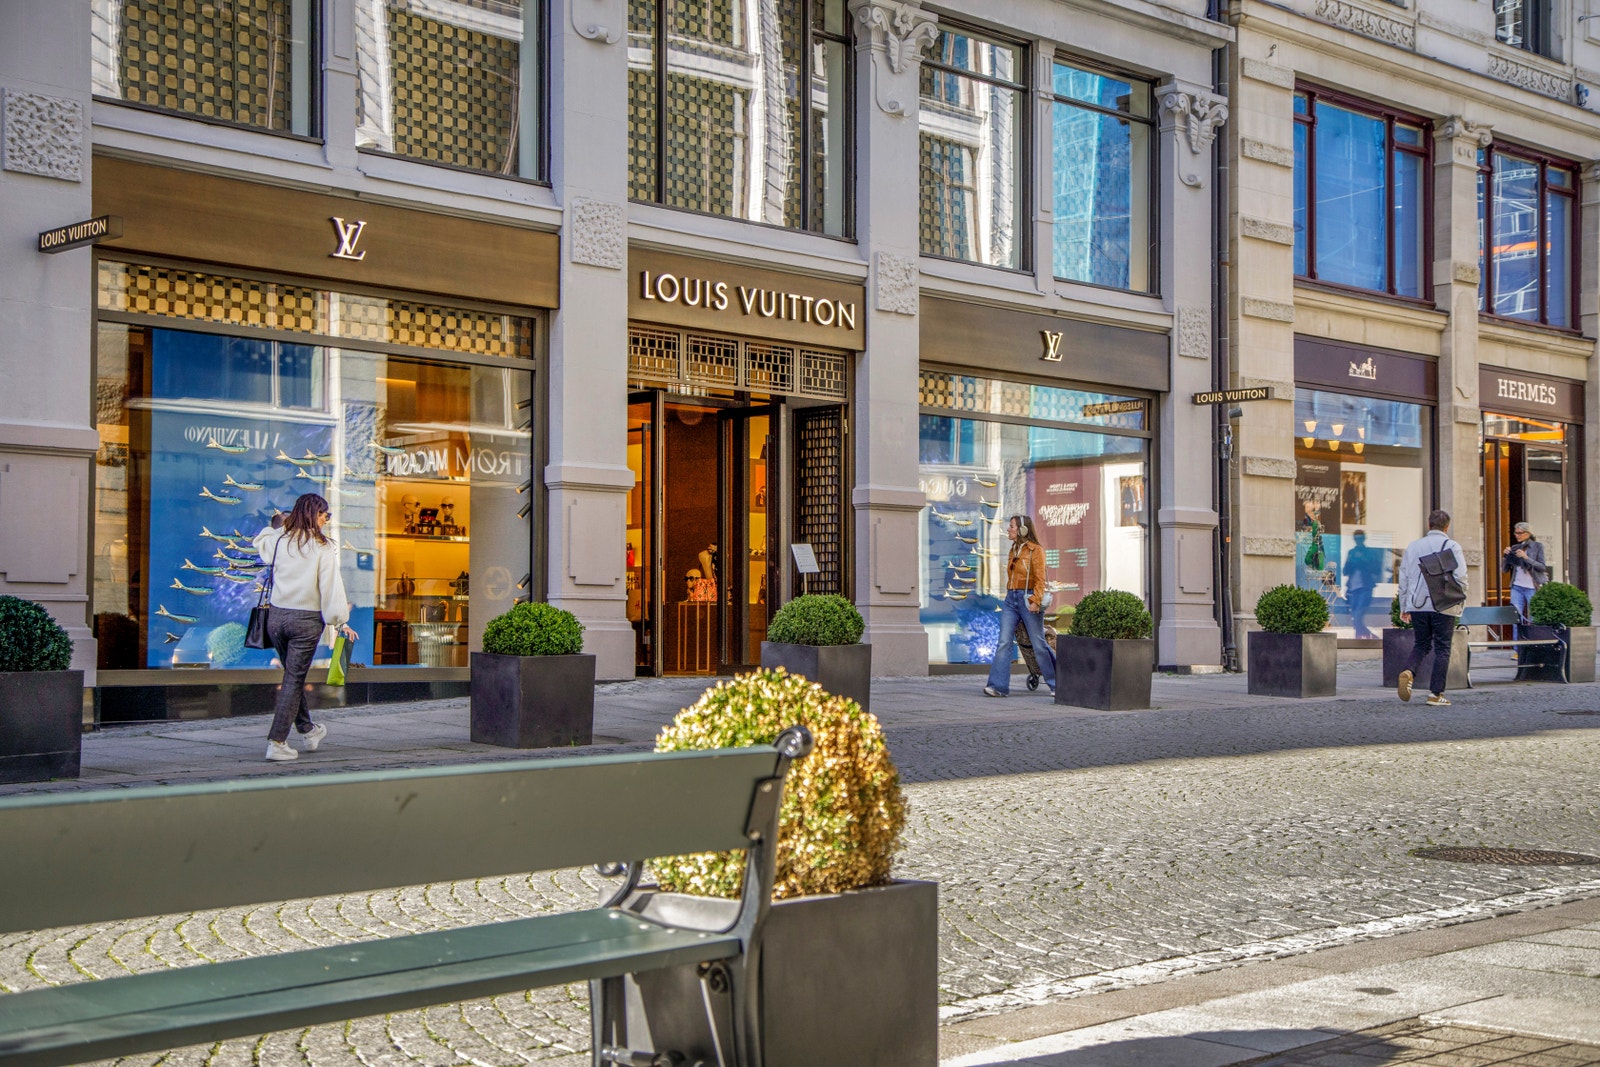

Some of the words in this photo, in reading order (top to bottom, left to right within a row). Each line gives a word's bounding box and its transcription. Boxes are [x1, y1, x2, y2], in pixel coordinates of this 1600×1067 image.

[41, 228, 66, 248] LOUIS
[68, 219, 107, 241] VUITTON
[642, 270, 728, 311] LOUIS
[737, 285, 855, 330] VUITTON
[1196, 392, 1224, 404] LOUIS
[1225, 388, 1267, 401] VUITTON
